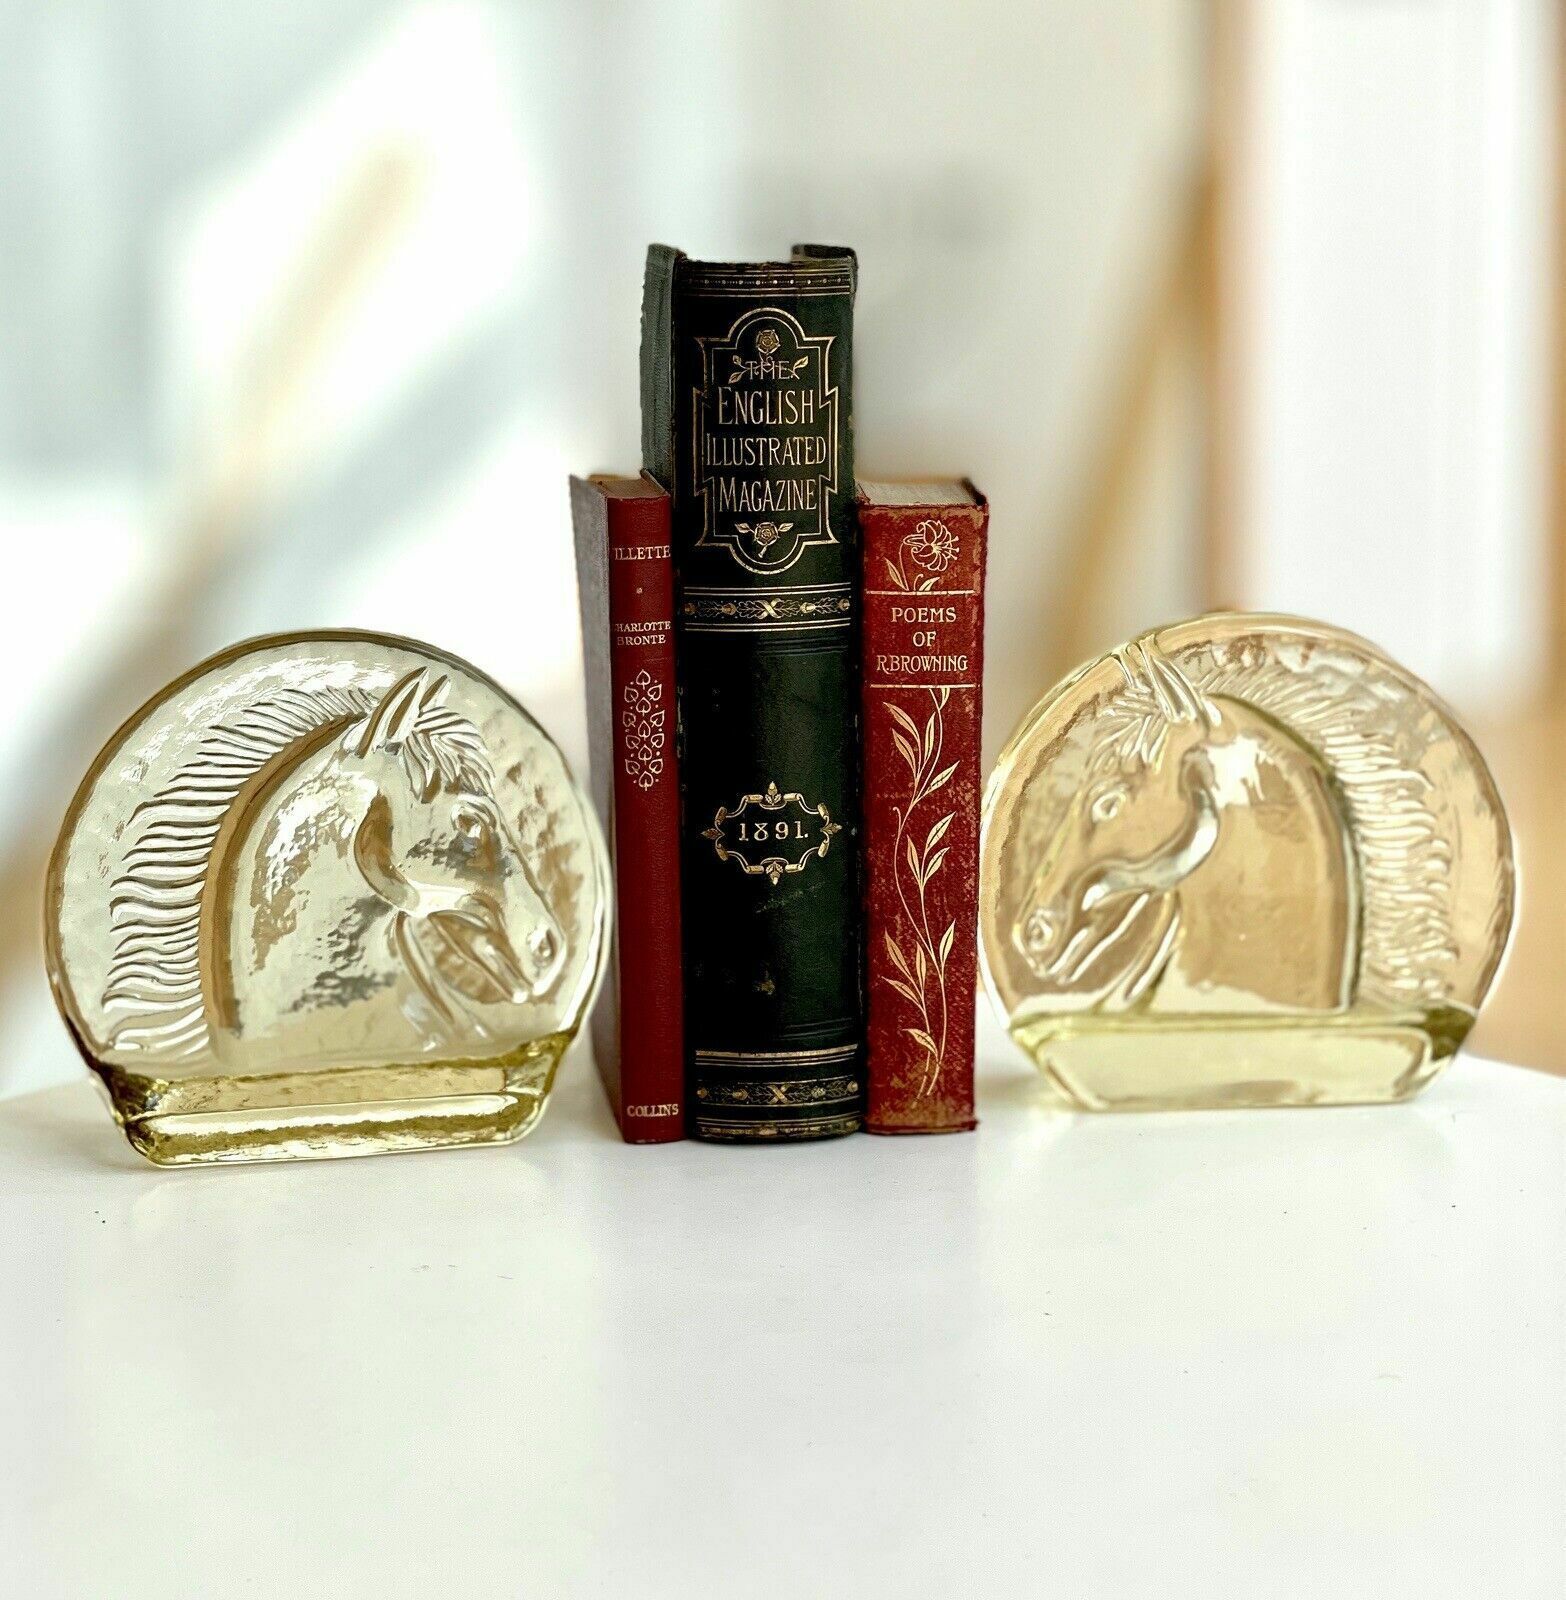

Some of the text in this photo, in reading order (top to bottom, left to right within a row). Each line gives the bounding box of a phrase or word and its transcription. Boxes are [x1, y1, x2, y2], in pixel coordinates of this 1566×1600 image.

[745, 360, 790, 380] THE
[718, 386, 815, 425] ENGLISH
[706, 433, 827, 466] ILLUSTRATED
[719, 477, 817, 512] MAGAZINE
[613, 545, 671, 560] ILLETTE
[891, 607, 957, 623] POEMS
[617, 634, 667, 646] BRONTE
[912, 631, 937, 647] OF
[738, 820, 809, 841] 1891.
[626, 1103, 679, 1117] COLLINS
